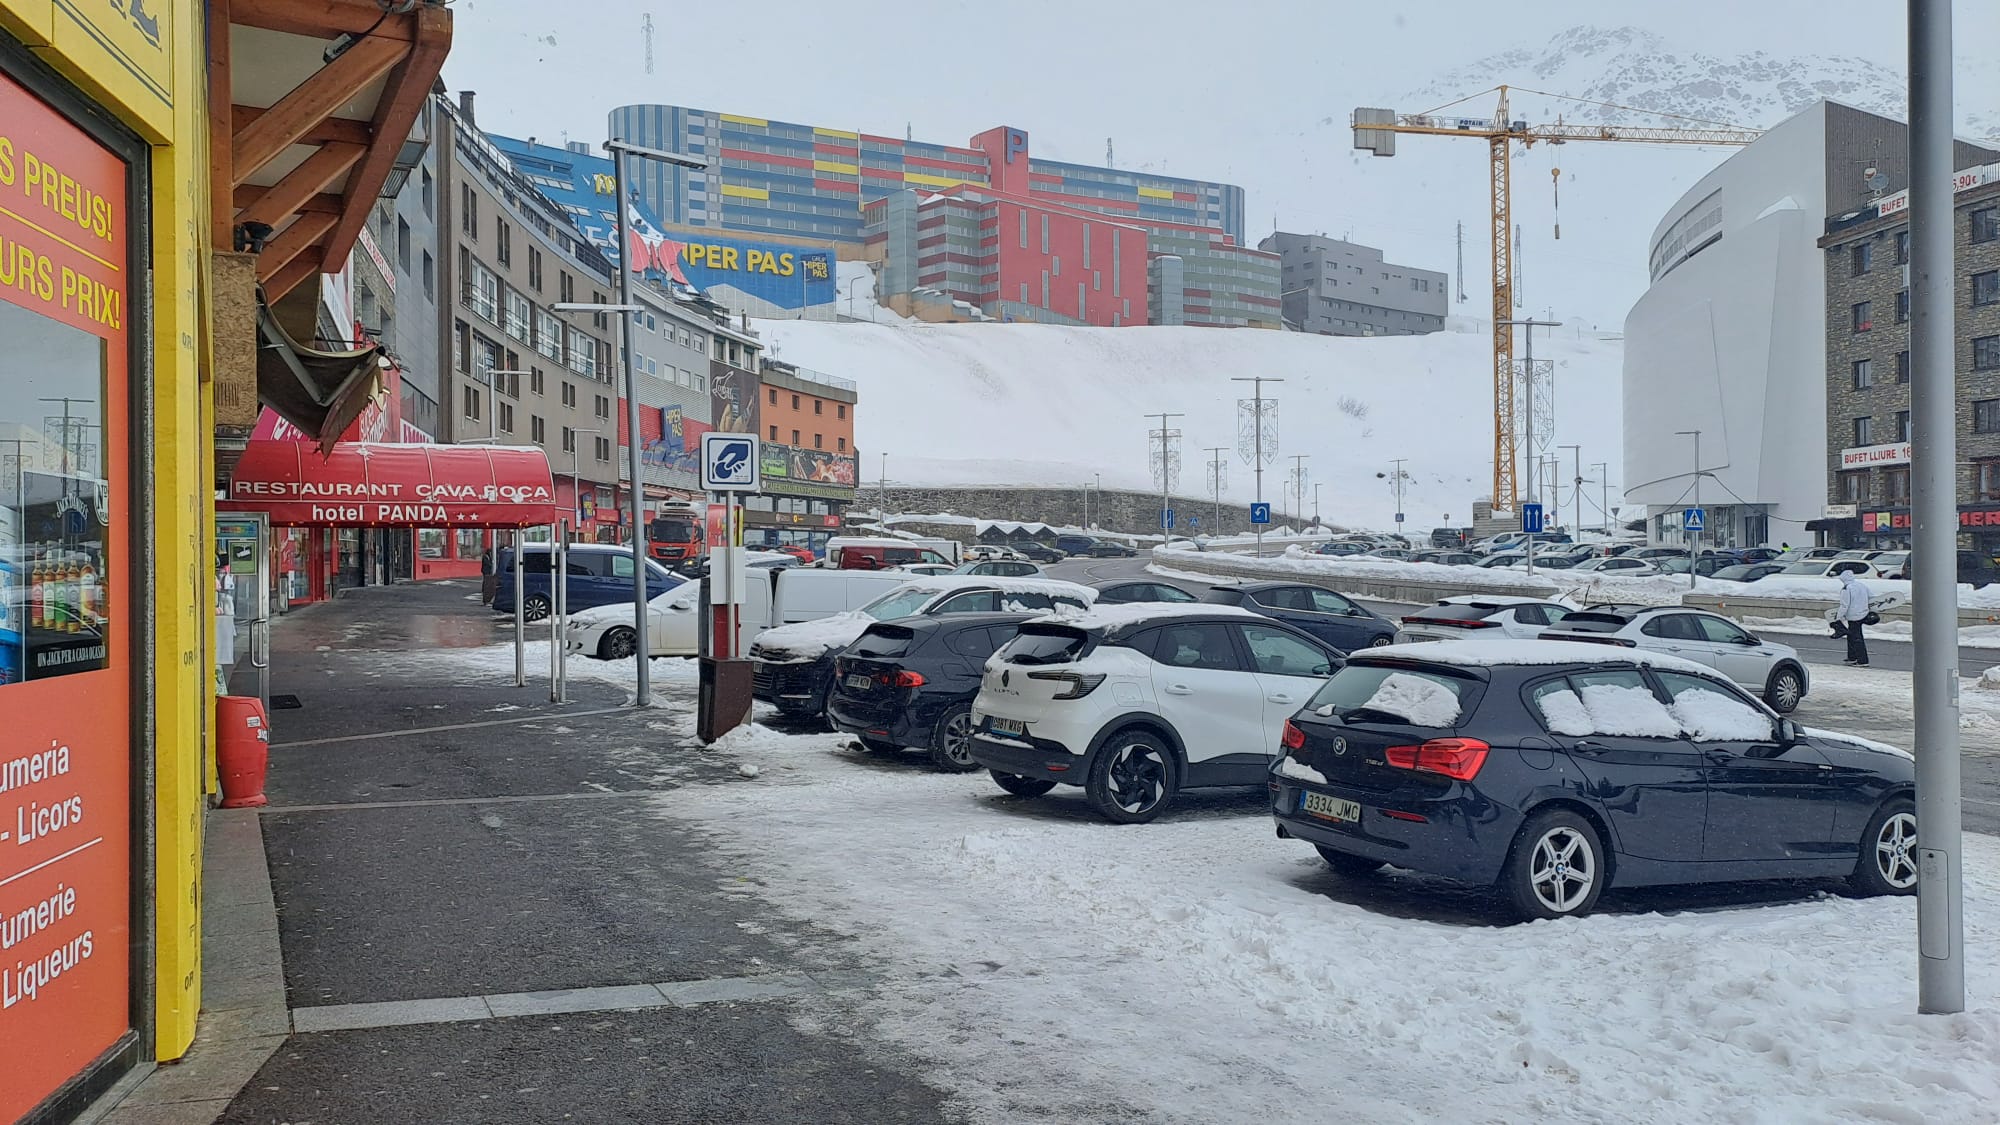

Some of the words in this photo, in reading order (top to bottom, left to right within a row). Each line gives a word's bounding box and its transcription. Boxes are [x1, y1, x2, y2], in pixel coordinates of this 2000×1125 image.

[1006, 128, 1027, 163] P
[24, 151, 112, 243] PREUS!
[1881, 196, 1906, 213] BUFET
[747, 249, 794, 277] PAS
[812, 269, 828, 279] PAS
[62, 265, 120, 330] PRIX!
[1844, 452, 1867, 464] BUFET
[1869, 448, 1897, 461] LLIURE
[235, 482, 402, 496] RESTAURANT
[415, 483, 474, 497] CAVA
[312, 504, 364, 521] hotel
[378, 505, 448, 521] PANDA
[47, 650, 61, 666] JACK
[61, 649, 71, 664] PER
[17, 793, 82, 845] Licors
[1307, 792, 1332, 812] 3334
[1336, 798, 1358, 820] JMC
[2, 930, 94, 1010] Liqueurs
